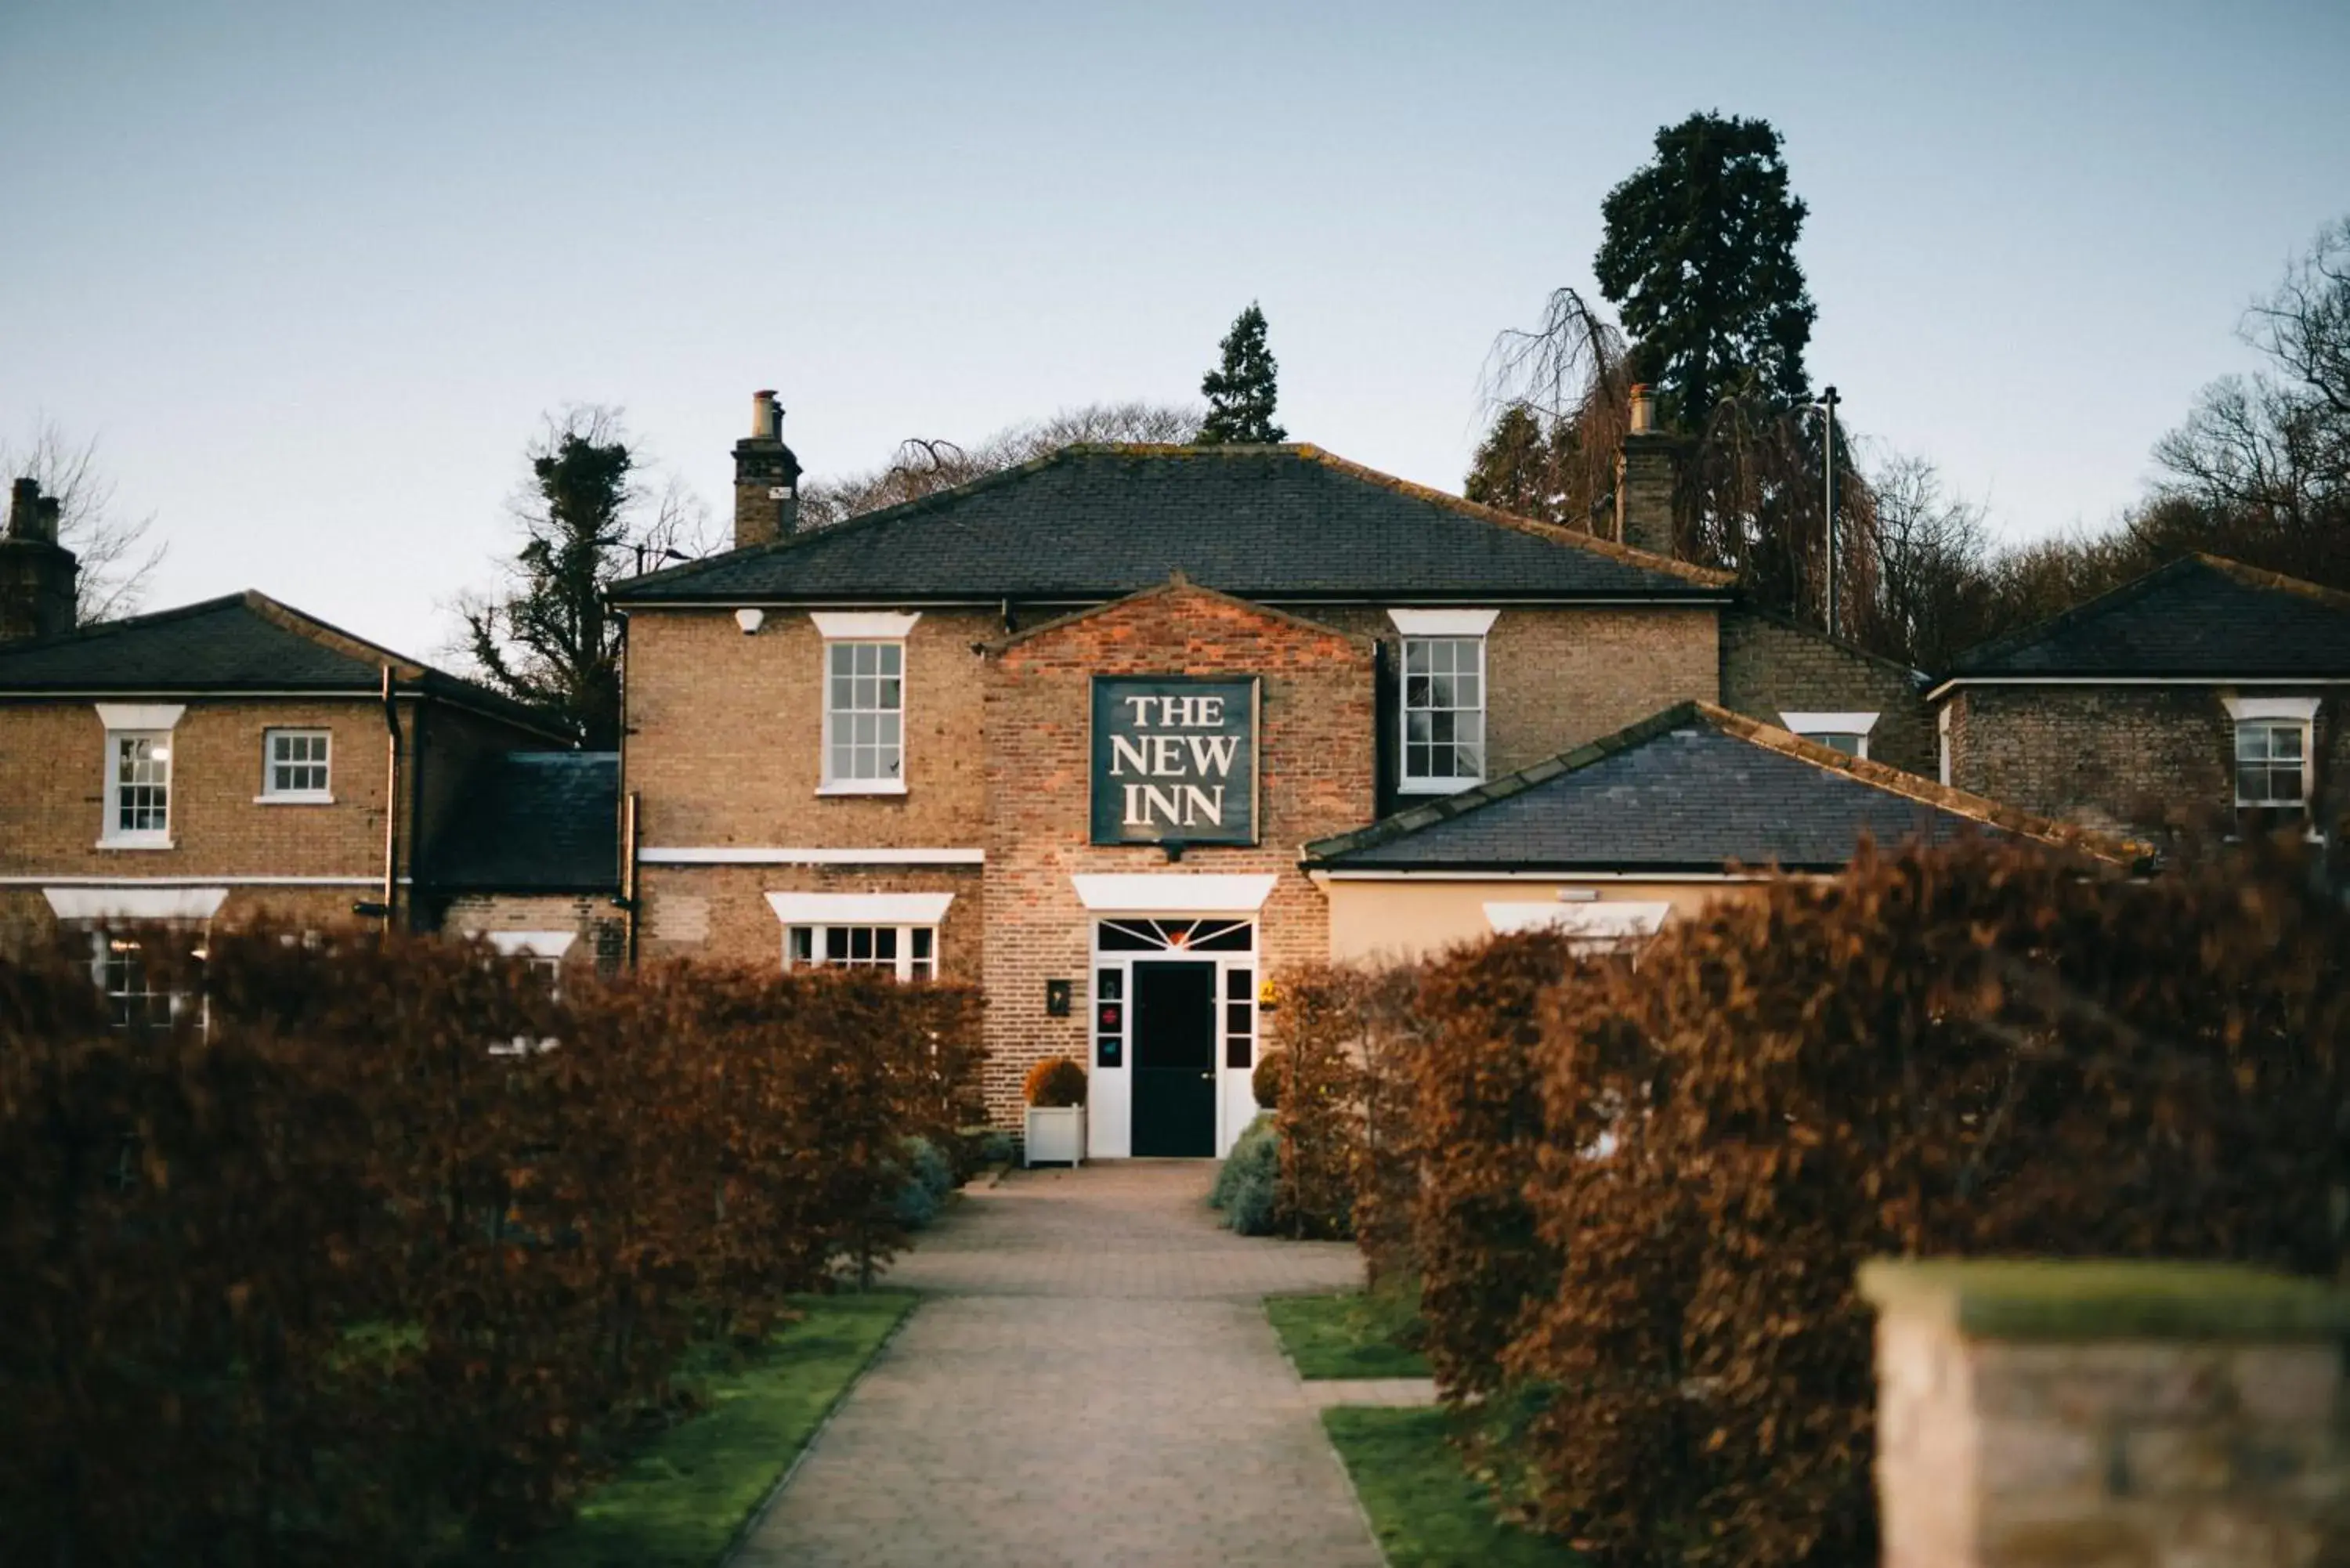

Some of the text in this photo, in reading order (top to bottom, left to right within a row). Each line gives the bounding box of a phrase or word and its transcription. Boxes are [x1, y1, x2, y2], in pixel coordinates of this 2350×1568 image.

[1125, 696, 1224, 727] THE
[1109, 735, 1241, 777] NEW
[1122, 784, 1225, 826] INN
